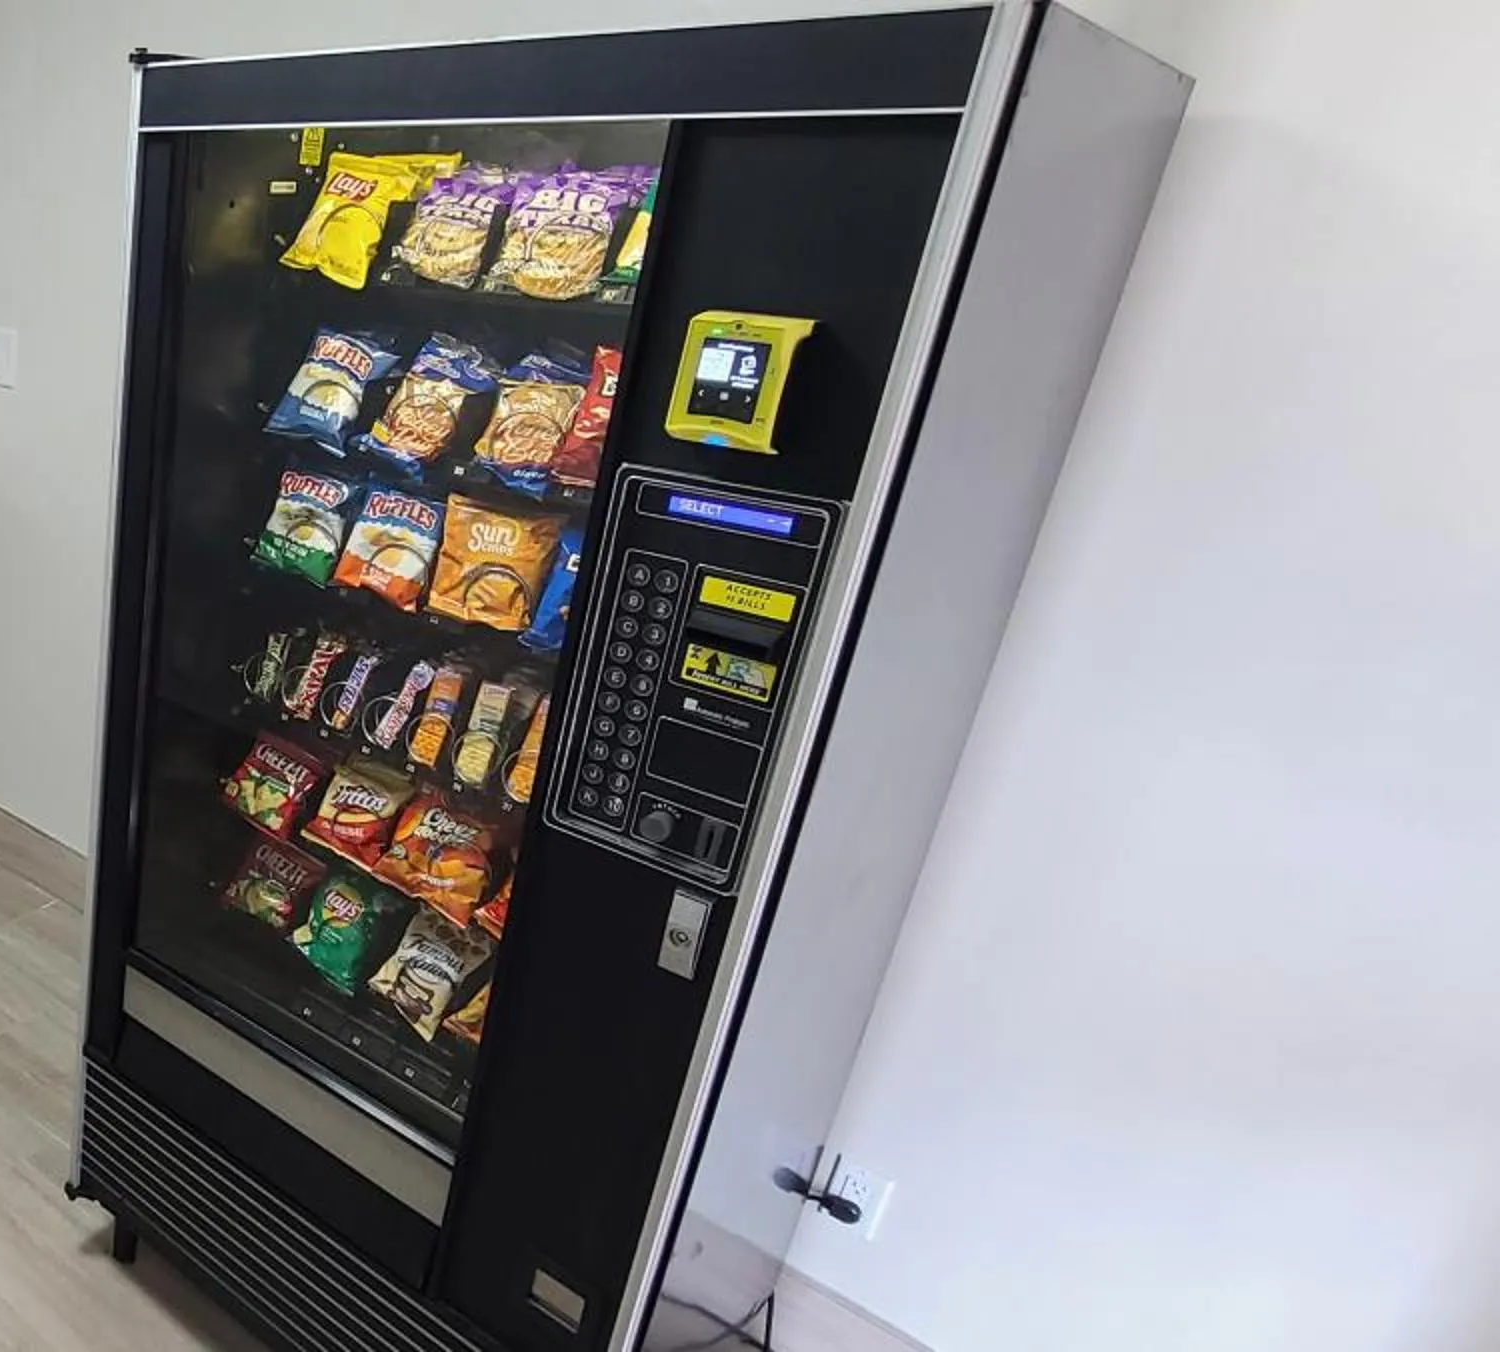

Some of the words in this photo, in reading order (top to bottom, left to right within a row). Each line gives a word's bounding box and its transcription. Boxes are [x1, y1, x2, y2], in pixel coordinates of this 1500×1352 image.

[531, 189, 606, 215] BIG
[516, 209, 610, 235] TEXAS
[314, 337, 372, 379] RUFFLES
[281, 471, 342, 509] RUFFLES
[366, 492, 437, 530] RUFFLES
[679, 500, 723, 517] SELECT
[468, 523, 516, 552] Sun
[726, 584, 771, 600] ACCEPTS
[737, 597, 766, 610] BILLS
[623, 621, 633, 633] C
[617, 647, 627, 657] D
[627, 729, 636, 740] 7
[608, 798, 622, 813] 10
